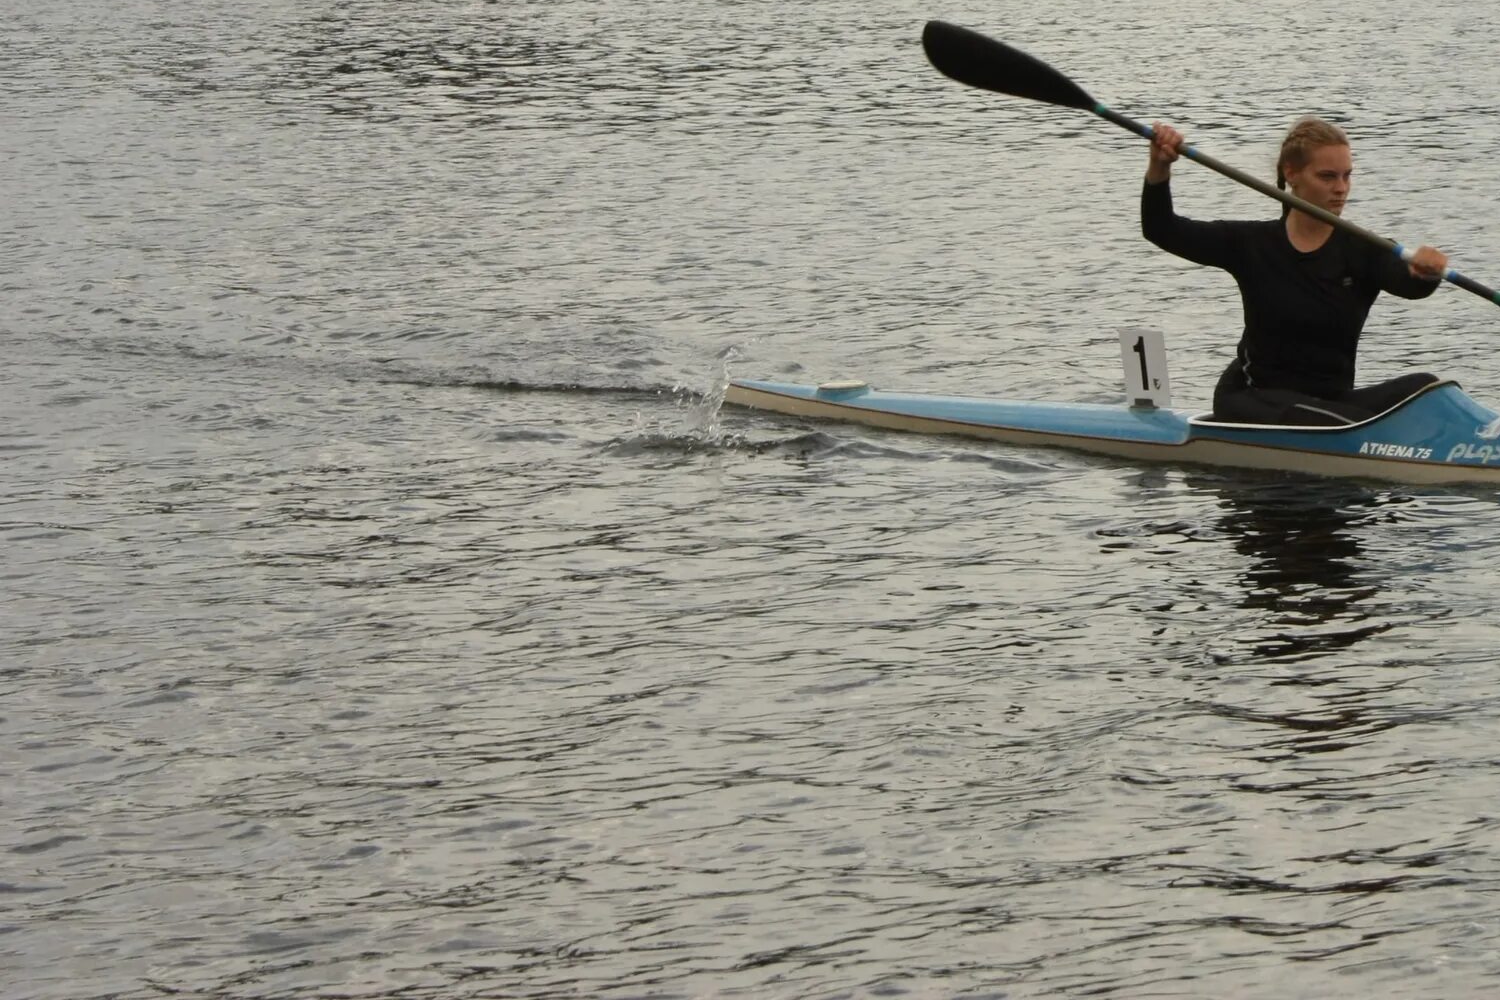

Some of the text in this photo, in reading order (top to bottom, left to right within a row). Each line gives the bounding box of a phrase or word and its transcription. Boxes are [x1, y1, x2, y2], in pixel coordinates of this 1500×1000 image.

[1132, 335, 1150, 391] 1
[1359, 441, 1433, 460] ATHENA 75
